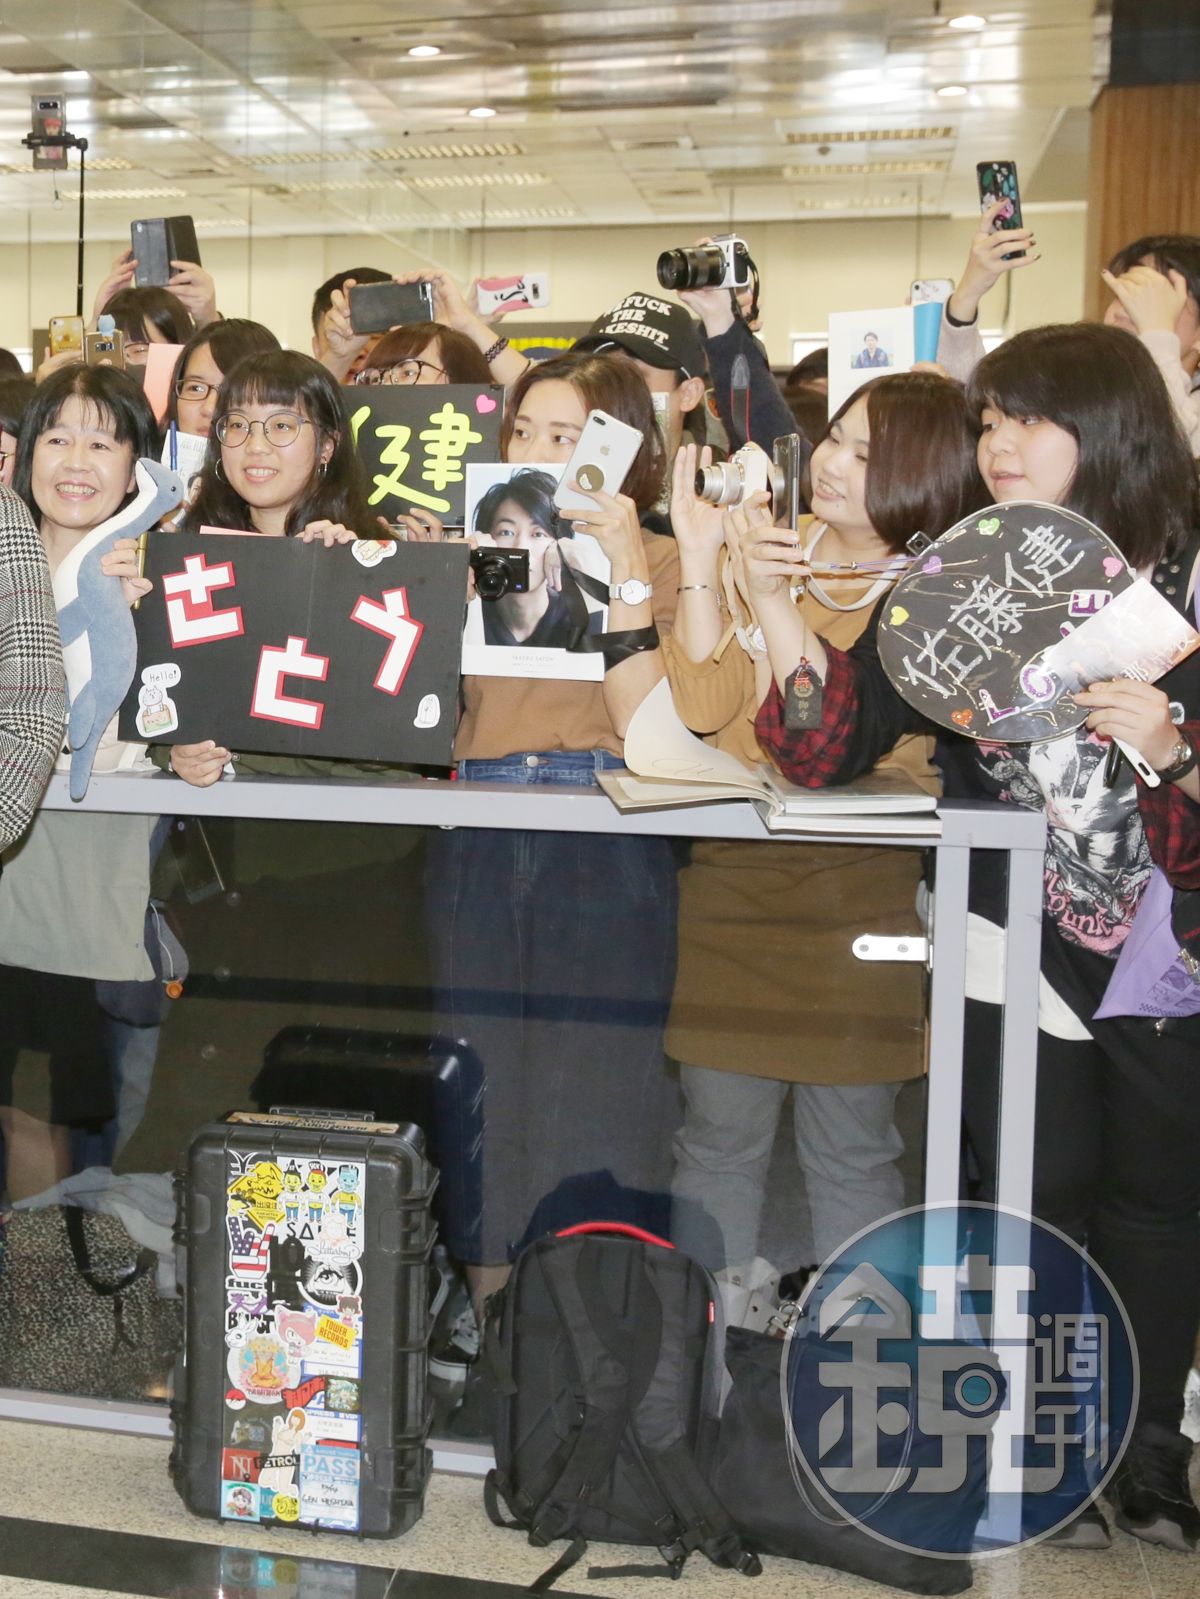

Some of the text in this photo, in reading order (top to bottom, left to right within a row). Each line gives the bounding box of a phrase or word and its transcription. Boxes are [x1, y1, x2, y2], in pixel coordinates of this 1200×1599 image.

[611, 308, 646, 323] THE
[623, 295, 672, 316] FUCK
[599, 322, 669, 344] KESHIT
[902, 524, 1085, 700] 佐藤健
[149, 669, 178, 683] Hello!
[319, 1328, 349, 1349] RECORDS
[324, 1319, 348, 1337] TOWER
[304, 1455, 356, 1477] PASS
